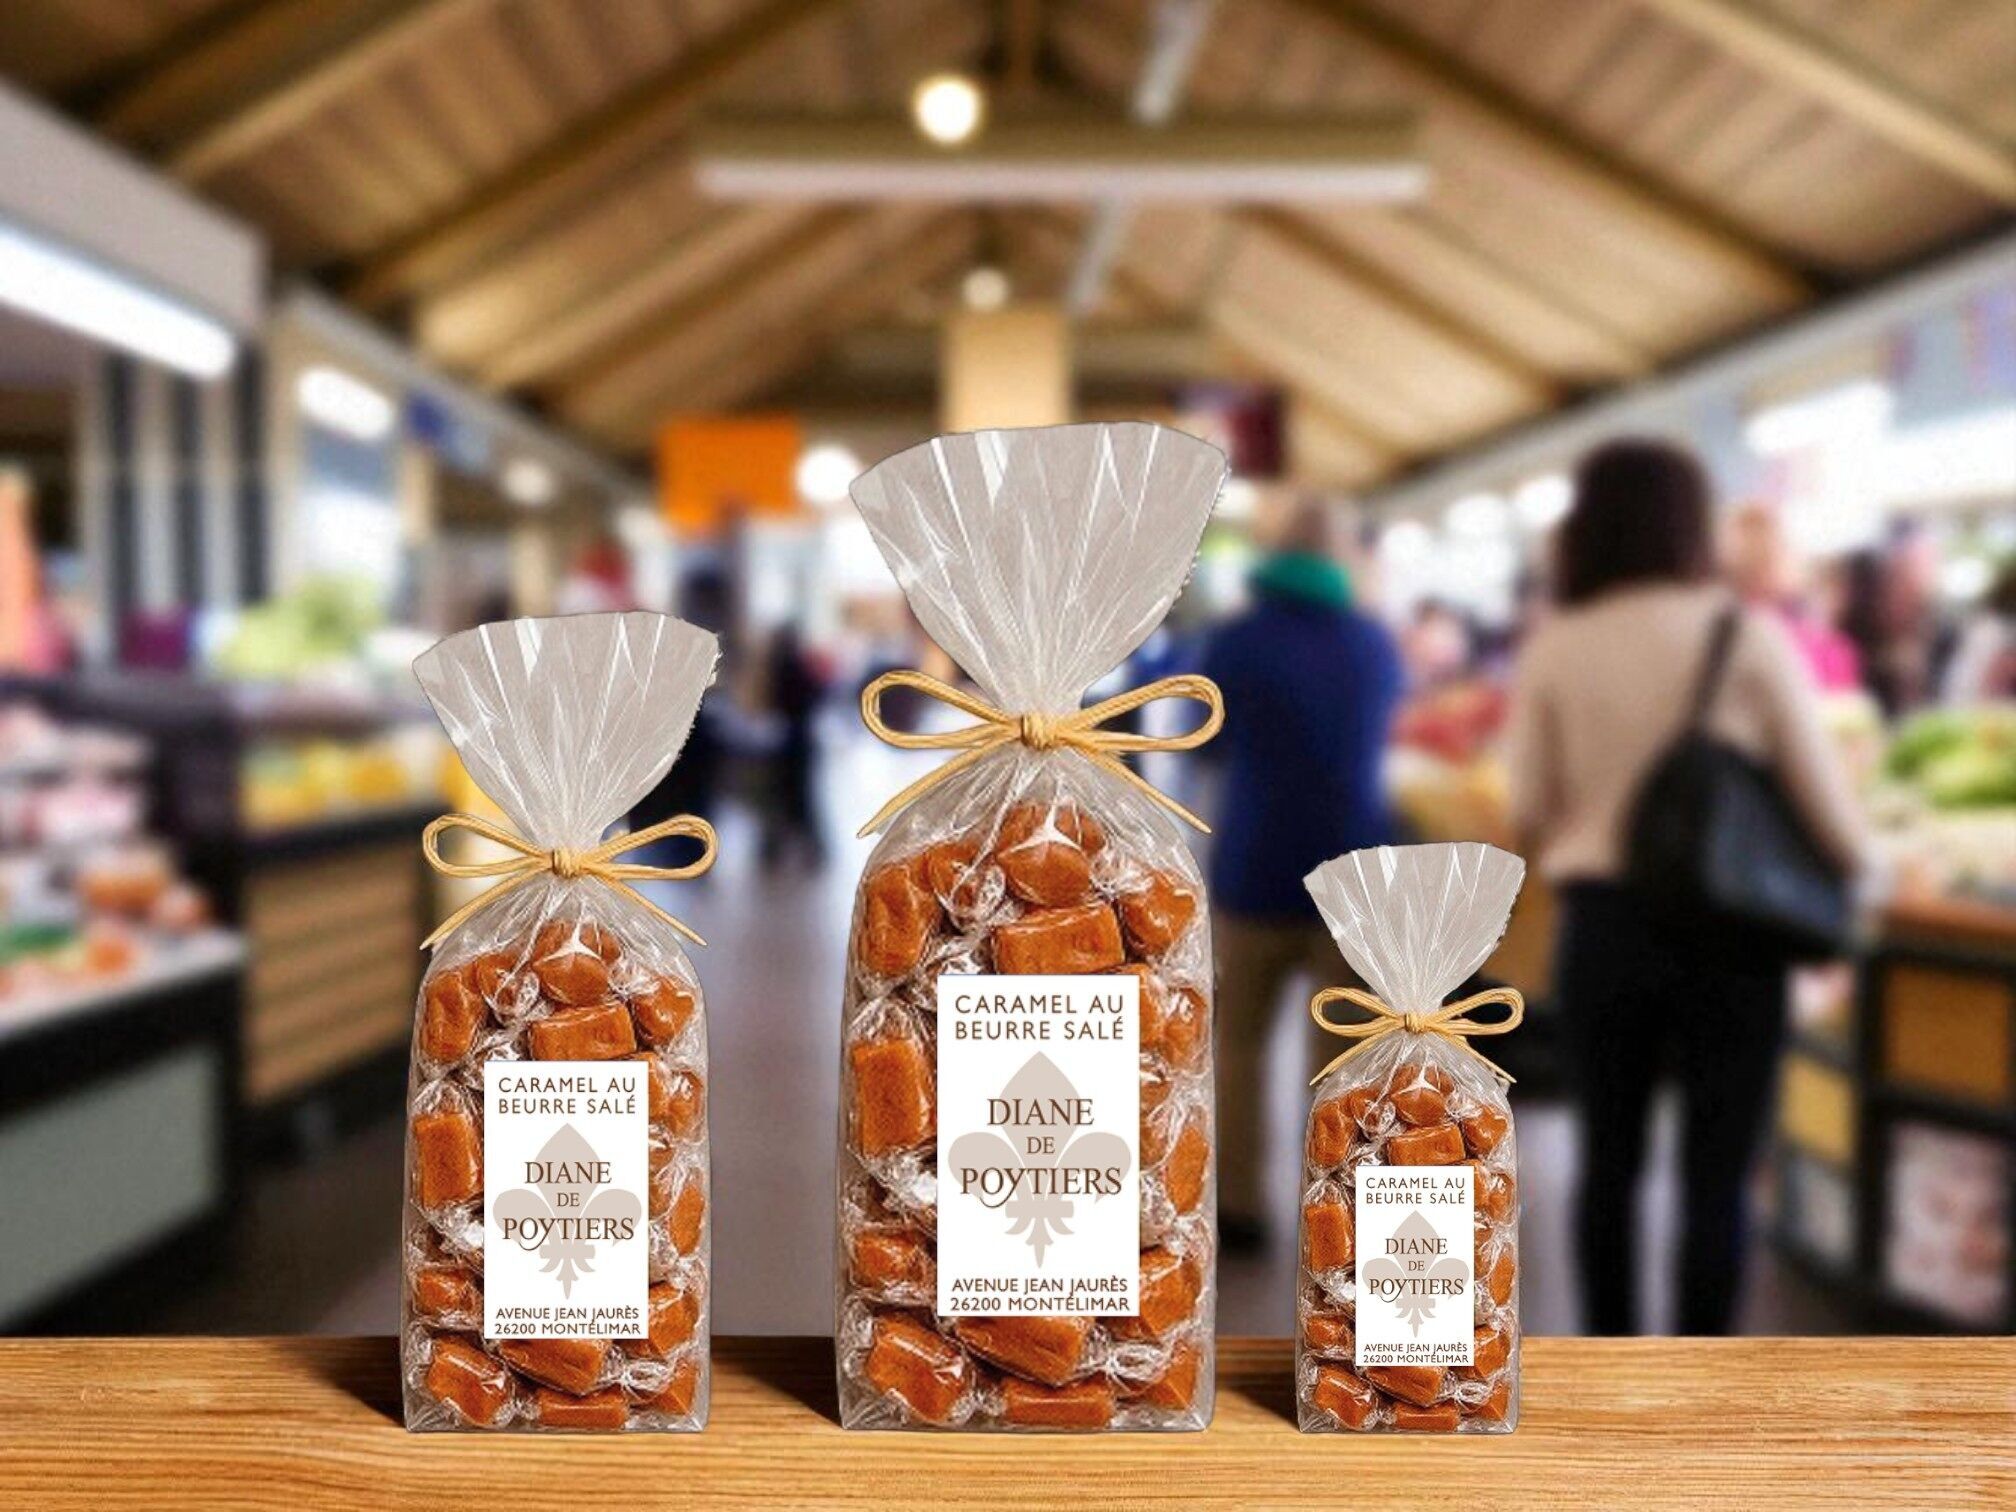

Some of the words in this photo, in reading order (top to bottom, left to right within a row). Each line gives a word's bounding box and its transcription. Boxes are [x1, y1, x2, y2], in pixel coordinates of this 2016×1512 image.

[956, 995, 1076, 1013] CARAMEL
[1089, 995, 1123, 1013] AU
[956, 1021, 1050, 1040] BEURRE
[1064, 1016, 1123, 1040] SALÉ
[499, 1077, 598, 1093] CARAMEL
[607, 1077, 635, 1093] AU
[499, 1098, 576, 1114] BEURRE
[587, 1095, 635, 1114] SALÉ
[987, 1098, 1094, 1125] DIANE
[1026, 1137, 1055, 1154] DE
[525, 1161, 611, 1184] DIANE
[961, 1167, 1122, 1208] POYTIERS
[1366, 1177, 1438, 1189] CARAMEL
[1444, 1177, 1465, 1189] AU
[556, 1192, 580, 1207] DE
[1366, 1192, 1422, 1204] BEURRE
[1429, 1190, 1465, 1204] SALÉ
[502, 1217, 634, 1251] POYTIERS
[1385, 1238, 1448, 1255] DIANE
[1408, 1260, 1425, 1272] DE
[952, 1278, 1018, 1293] AVENUE
[1024, 1278, 1064, 1295] JEAN
[1070, 1276, 1128, 1297] JAURÈS
[1369, 1278, 1464, 1303] POYTIERS
[950, 1297, 1001, 1311] 26200
[1008, 1294, 1130, 1311] MONTÉLIMAR
[496, 1307, 550, 1320] AVENUE
[554, 1307, 587, 1322] JEAN
[592, 1305, 639, 1324] JAURÈS
[495, 1322, 536, 1335] 26200
[542, 1319, 641, 1335] MONTÉLIMAR
[1364, 1343, 1403, 1353] AVENUE
[1406, 1343, 1430, 1354] JEAN
[1433, 1342, 1468, 1356] JAURÈS
[1363, 1354, 1393, 1364] 26200
[1397, 1352, 1469, 1364] MONTÉLIMAR
